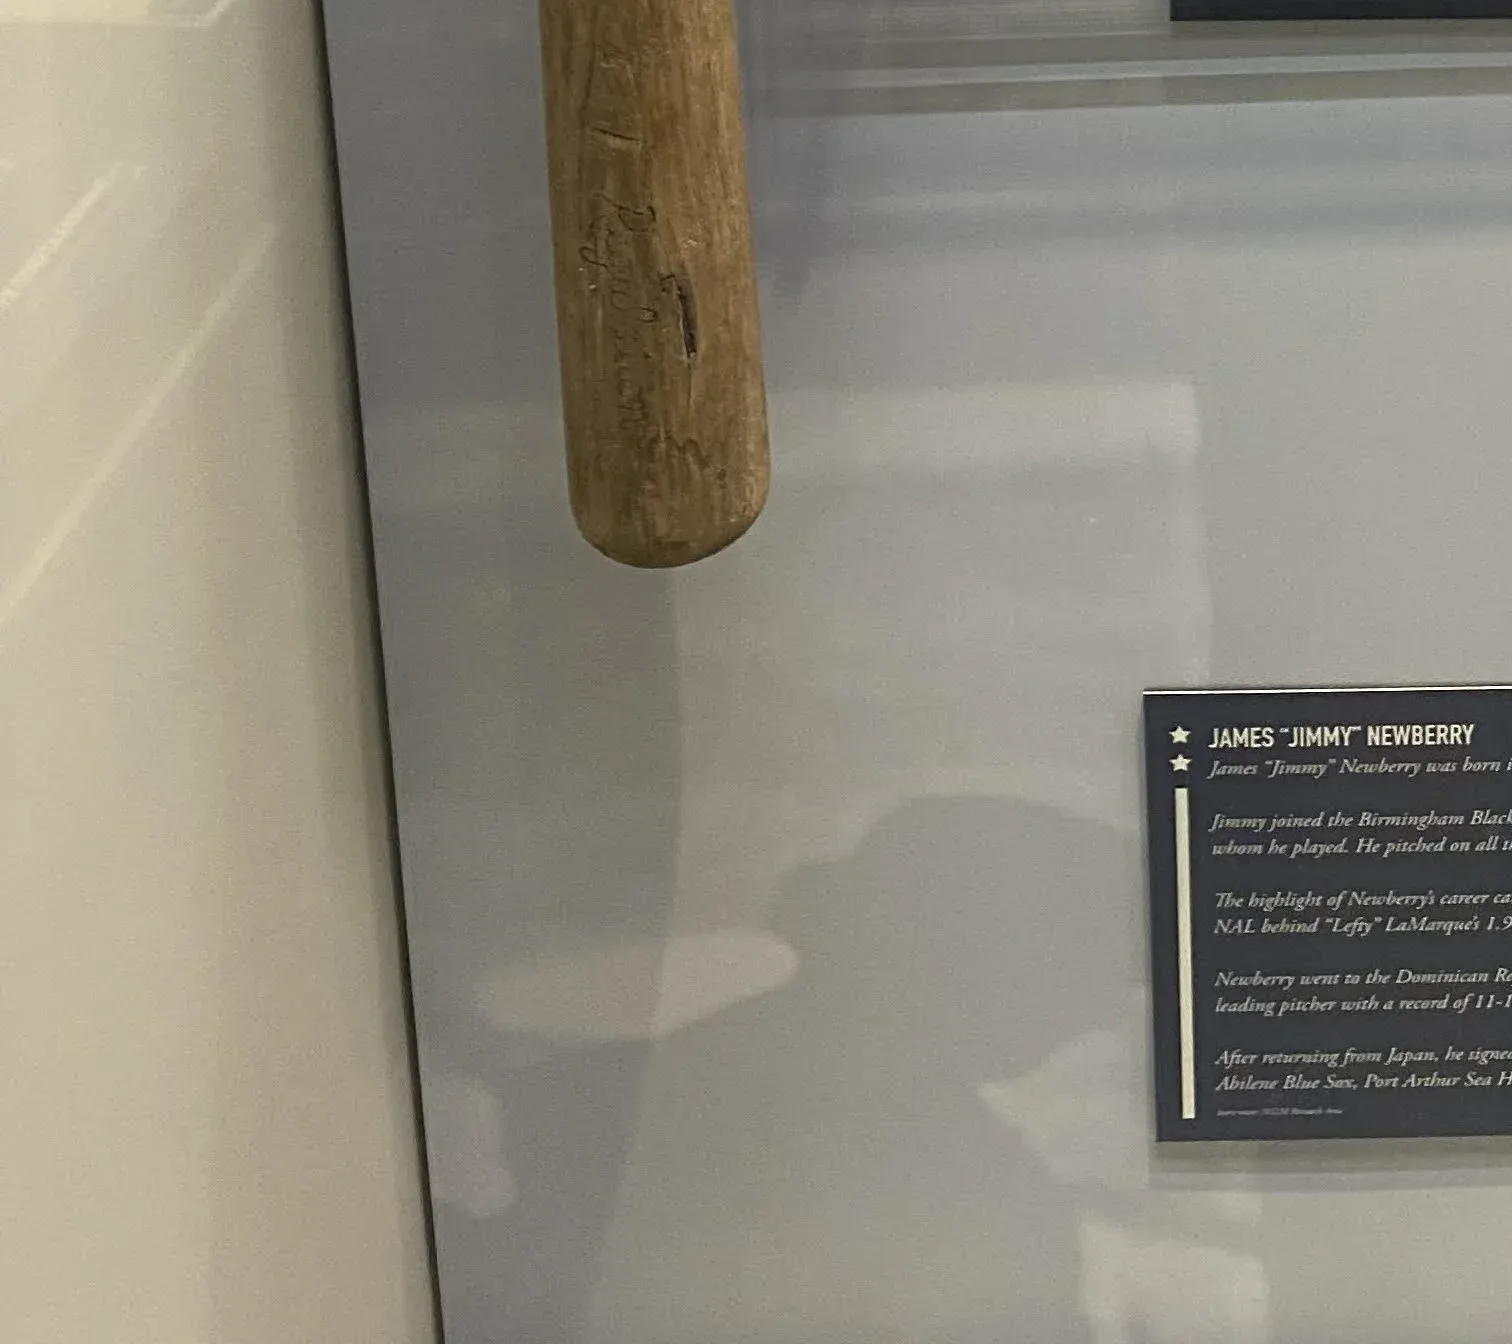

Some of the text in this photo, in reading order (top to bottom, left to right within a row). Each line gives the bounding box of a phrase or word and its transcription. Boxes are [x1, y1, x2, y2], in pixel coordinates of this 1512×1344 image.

[1209, 724, 1474, 748] JAMES "JIMMY" NEWBERRY
[1207, 761, 1258, 780] James
[1266, 759, 1335, 778] "Jimmy"
[1339, 759, 1420, 777] Newberry
[1426, 763, 1456, 772] was
[1463, 758, 1500, 772] born
[1209, 814, 1265, 832] Jimmy
[1269, 812, 1325, 831] joined
[1329, 812, 1352, 827] the
[1358, 812, 1464, 831] Birmingham
[1213, 841, 1263, 855] whom
[1268, 841, 1287, 854] he
[1290, 839, 1350, 859] played.
[1357, 839, 1381, 853] He
[1384, 837, 1448, 858] pitched
[1450, 840, 1470, 852] on
[1475, 836, 1498, 851] all
